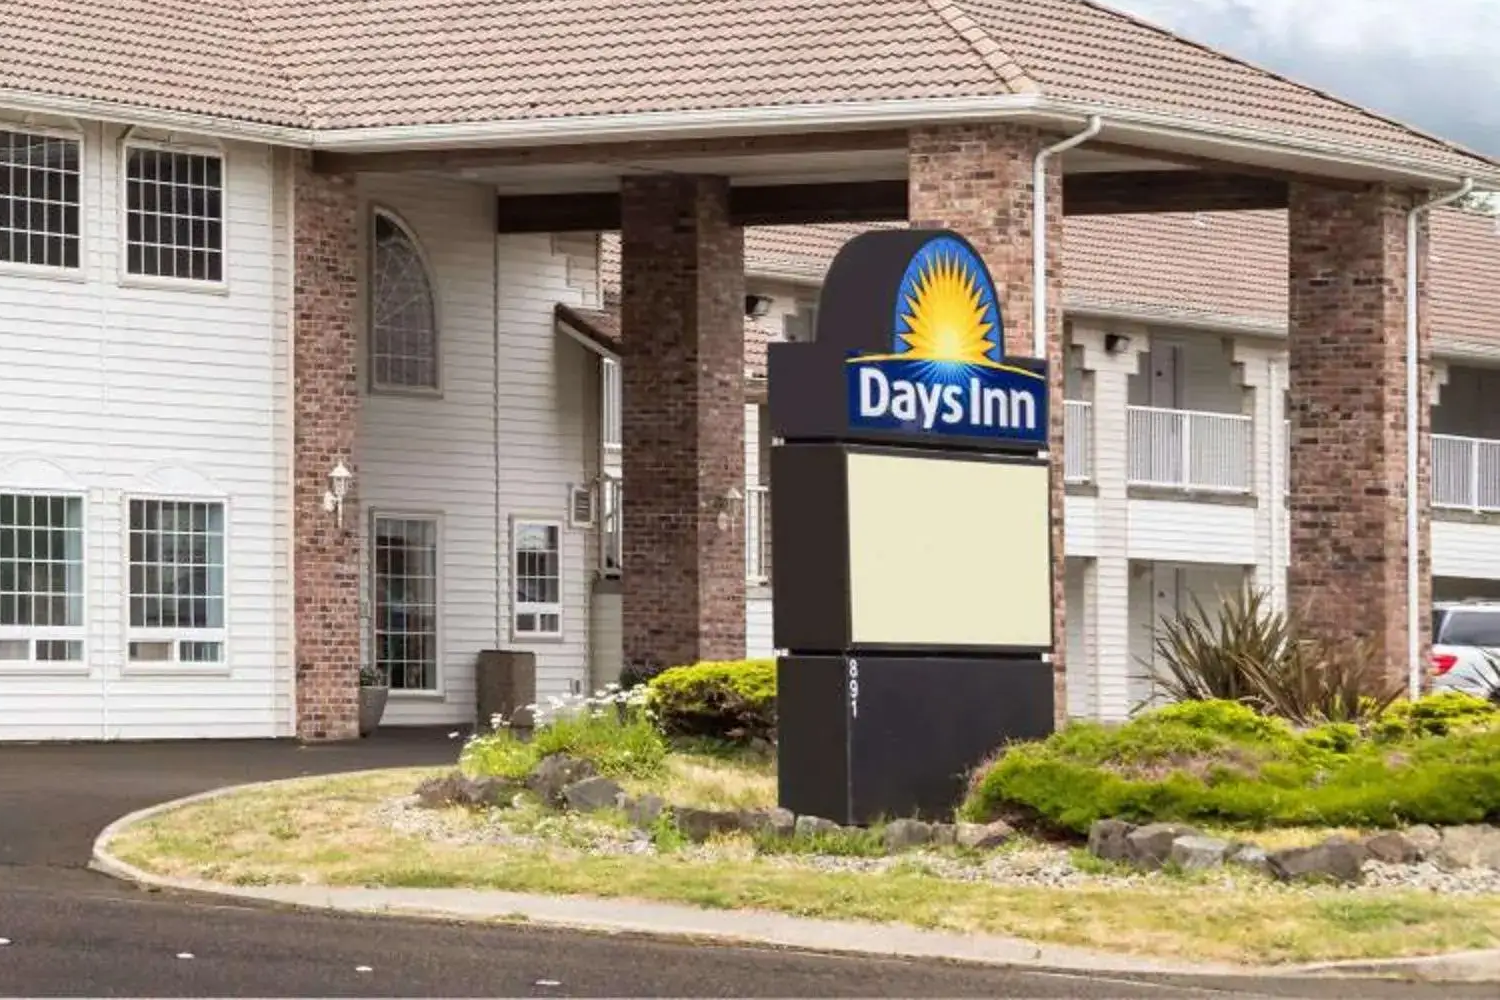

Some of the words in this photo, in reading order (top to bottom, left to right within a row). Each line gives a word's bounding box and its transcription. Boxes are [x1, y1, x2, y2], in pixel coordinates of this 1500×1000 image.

[859, 367, 964, 429] Days
[970, 377, 1036, 429] Inn
[849, 658, 858, 718] 891
